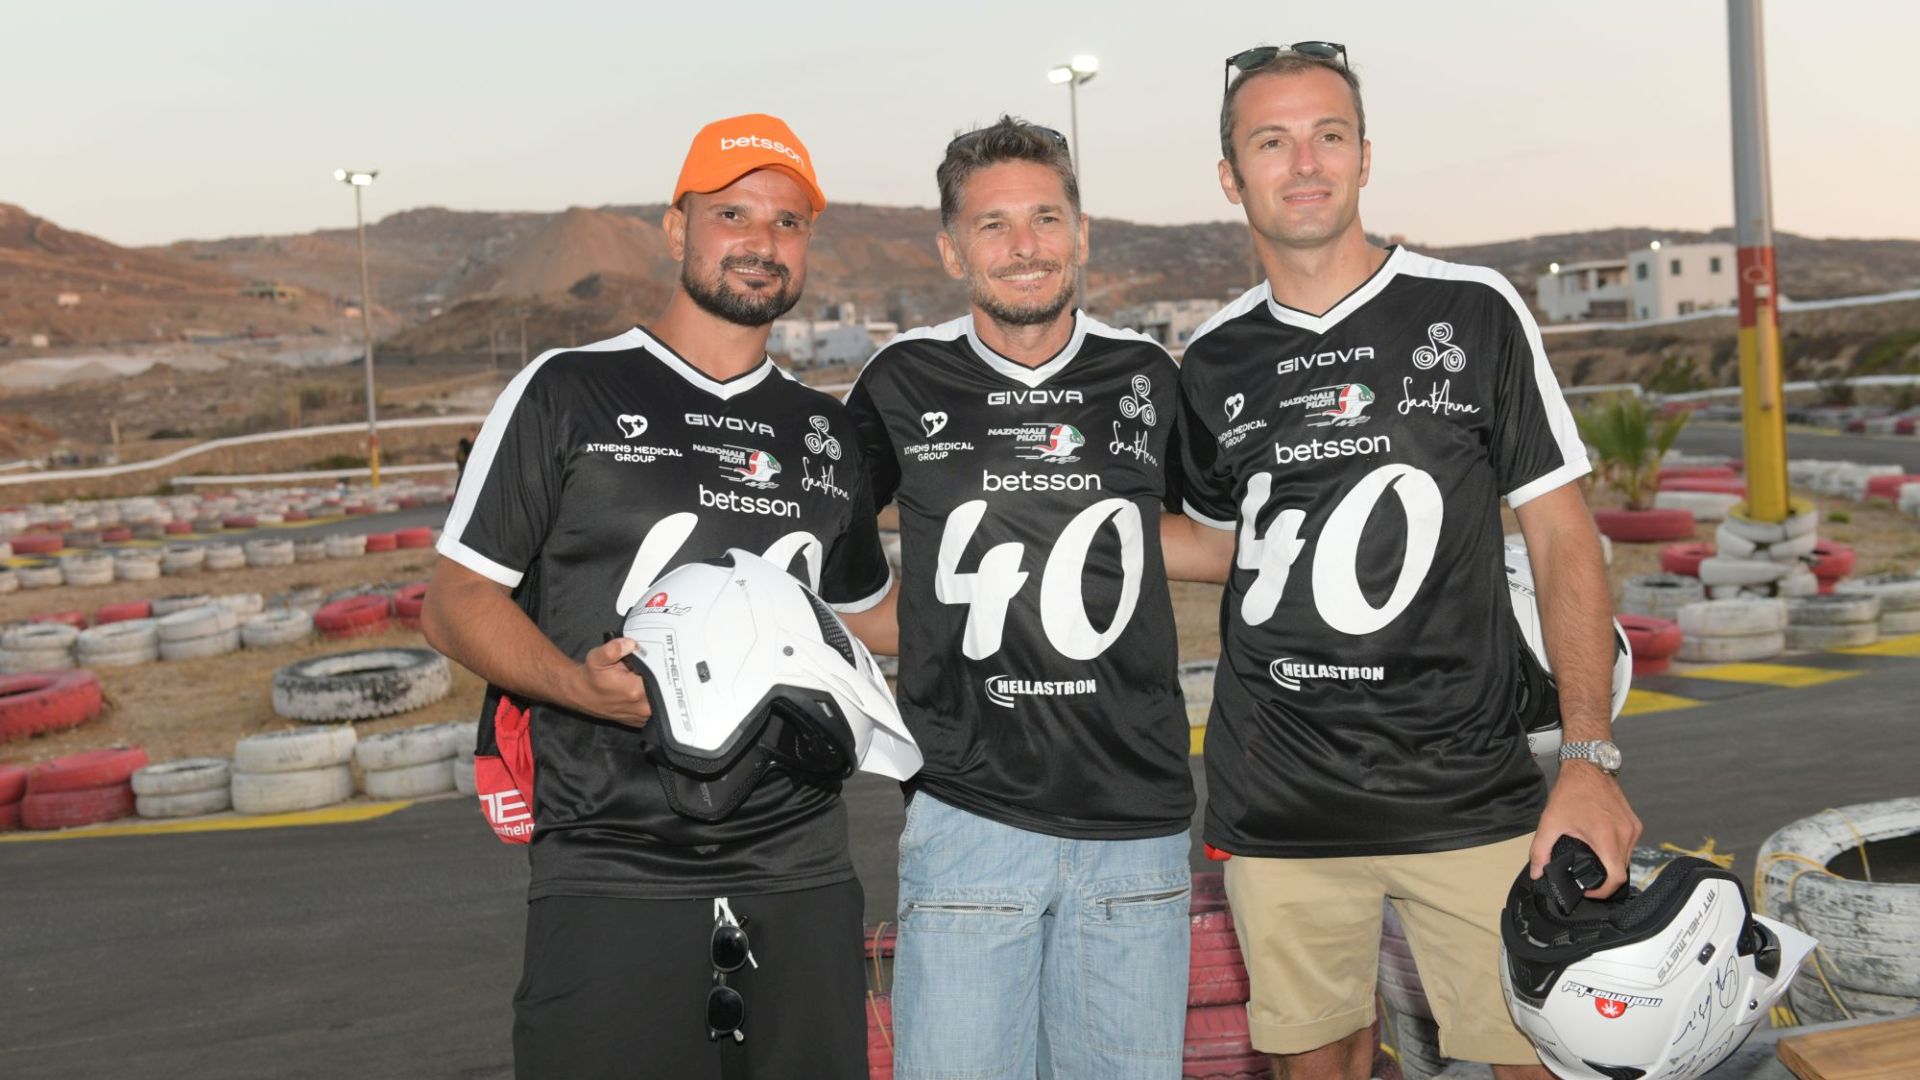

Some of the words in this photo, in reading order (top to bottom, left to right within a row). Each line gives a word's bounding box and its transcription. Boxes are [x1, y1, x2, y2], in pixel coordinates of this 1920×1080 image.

[721, 135, 805, 168] betsson
[1277, 346, 1375, 375] GIVOVA
[987, 389, 1084, 406] GIVOVA
[1279, 391, 1335, 408] NAZIONALE
[1305, 398, 1335, 410] PILOTI
[684, 412, 775, 438] GIVOVA
[986, 427, 1047, 436] NAZIONALE
[1233, 419, 1268, 435] MEDICAL
[586, 443, 632, 454] ATHENS
[633, 446, 683, 457] MEDICAL
[692, 443, 745, 459] NAZIONALE
[917, 451, 949, 462] GROUP
[931, 442, 975, 452] MEDICAL
[1275, 434, 1391, 465] betsson
[614, 453, 656, 463] GROUP
[720, 454, 746, 466] PILOTI
[982, 470, 1101, 492] betsson
[699, 483, 801, 519] betsson
[1236, 463, 1444, 636] 40
[935, 497, 1144, 661] 40
[1282, 662, 1385, 681] HELLASTRON
[668, 657, 693, 733] HELMETS
[997, 678, 1097, 696] HELLASTRON
[1704, 889, 1716, 915] MT
[1657, 909, 1703, 983] HELMETS
[1562, 980, 1663, 1009] motomarket
